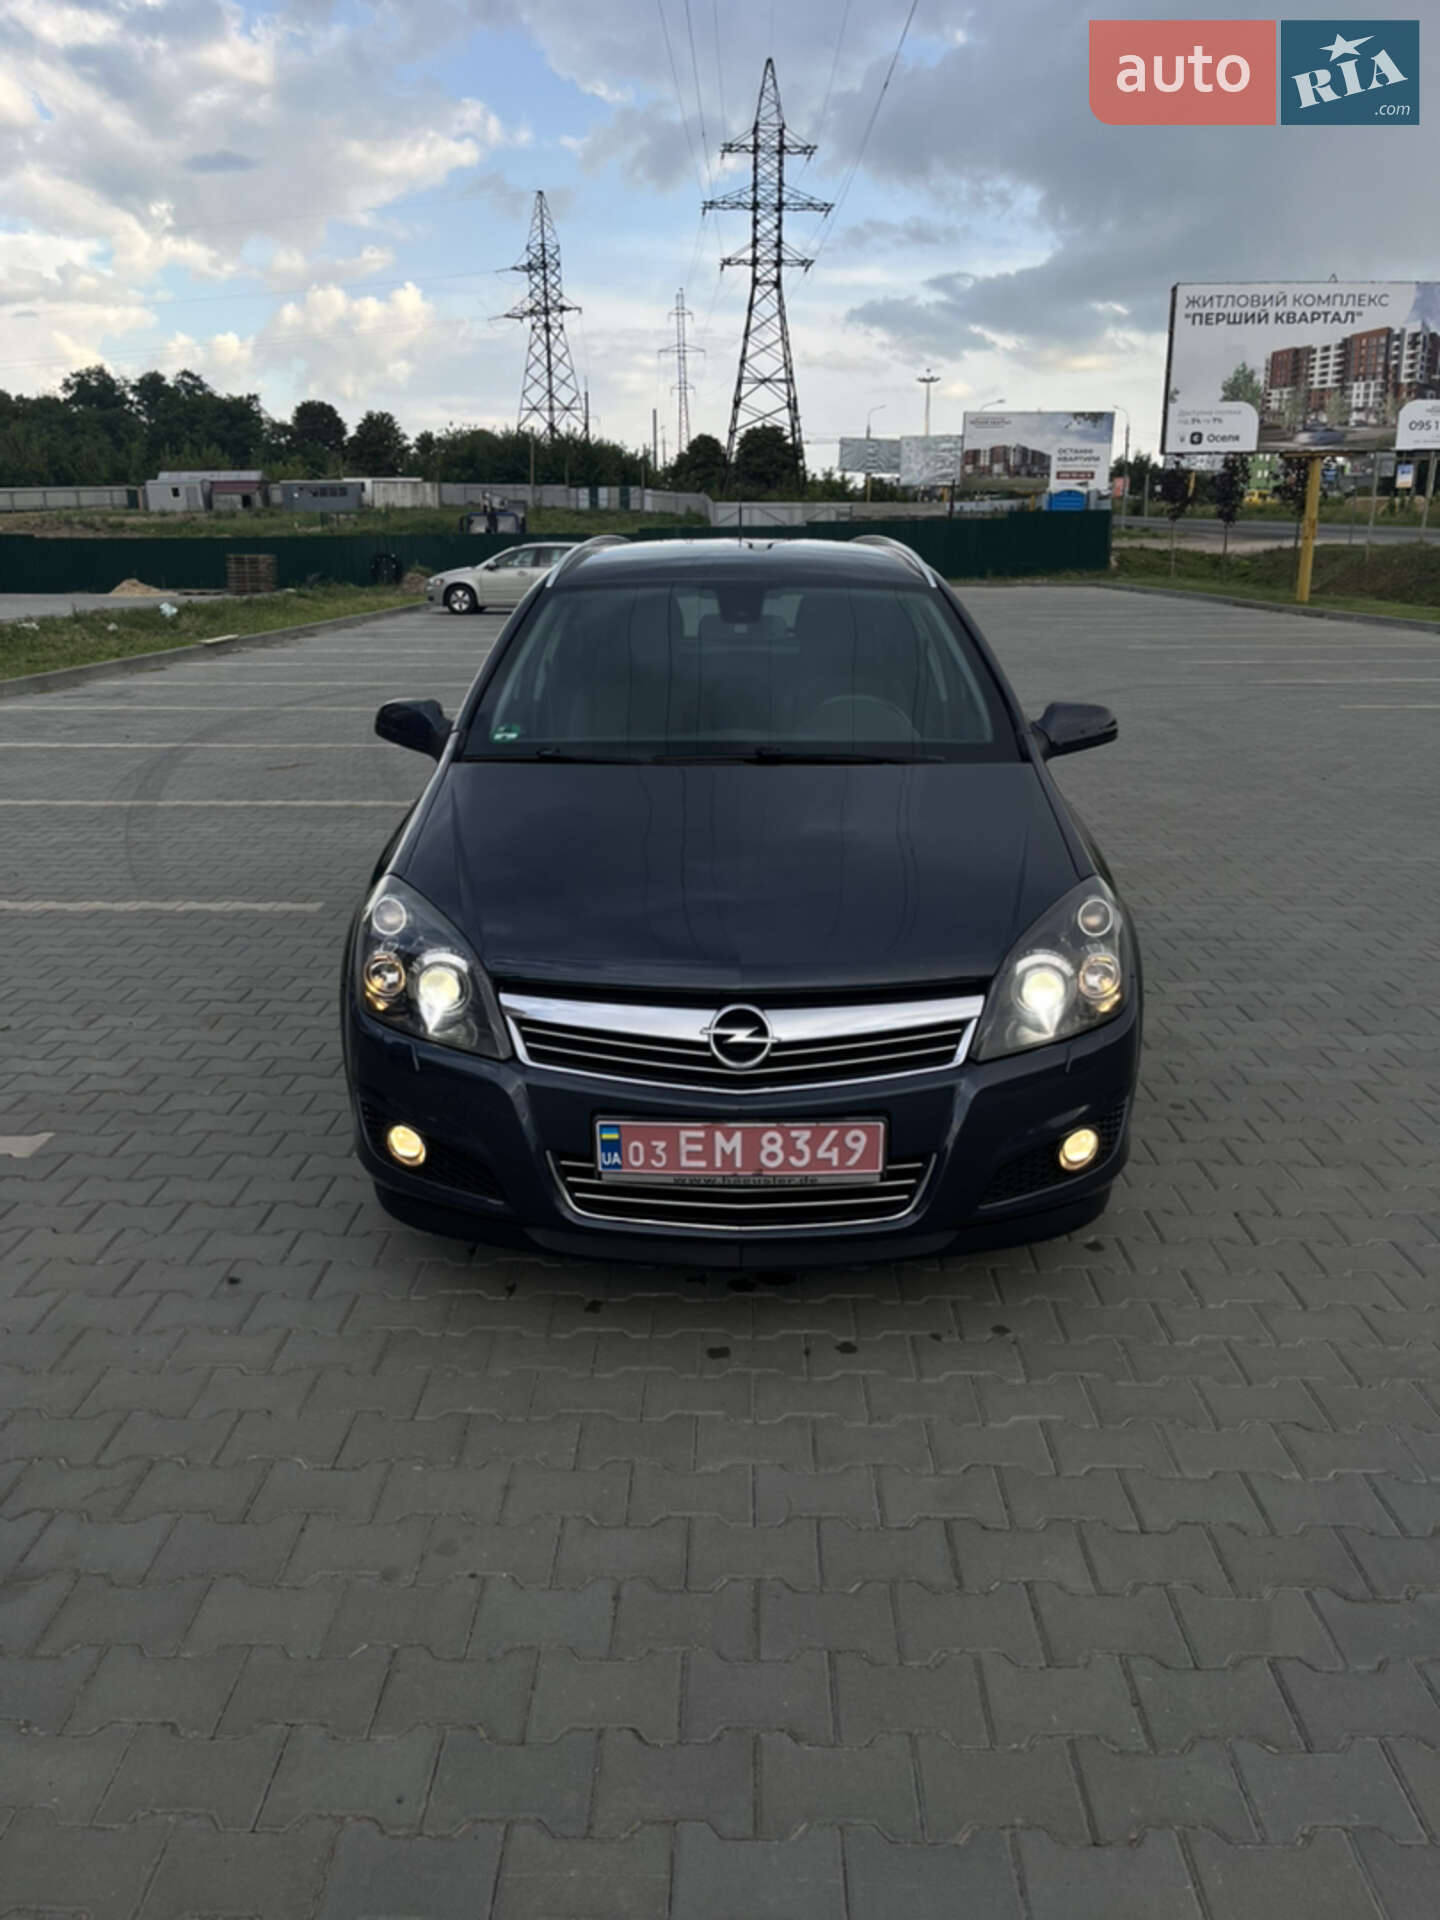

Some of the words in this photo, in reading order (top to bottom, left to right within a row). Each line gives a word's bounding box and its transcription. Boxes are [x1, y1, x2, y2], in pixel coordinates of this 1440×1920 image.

[1185, 291, 1288, 309] ЖИТЛОВИЙ
[1292, 293, 1390, 308] КОМПЛЕКС
[1184, 309, 1269, 326] "ПЕРШИЙ
[1274, 310, 1363, 325] КВАРТАЛ"
[1408, 420, 1432, 431] 095
[1207, 433, 1240, 443] Оселя
[628, 1141, 667, 1168] 03
[679, 1130, 742, 1168] EM
[760, 1129, 868, 1168] 8349
[601, 1152, 621, 1166] UA
